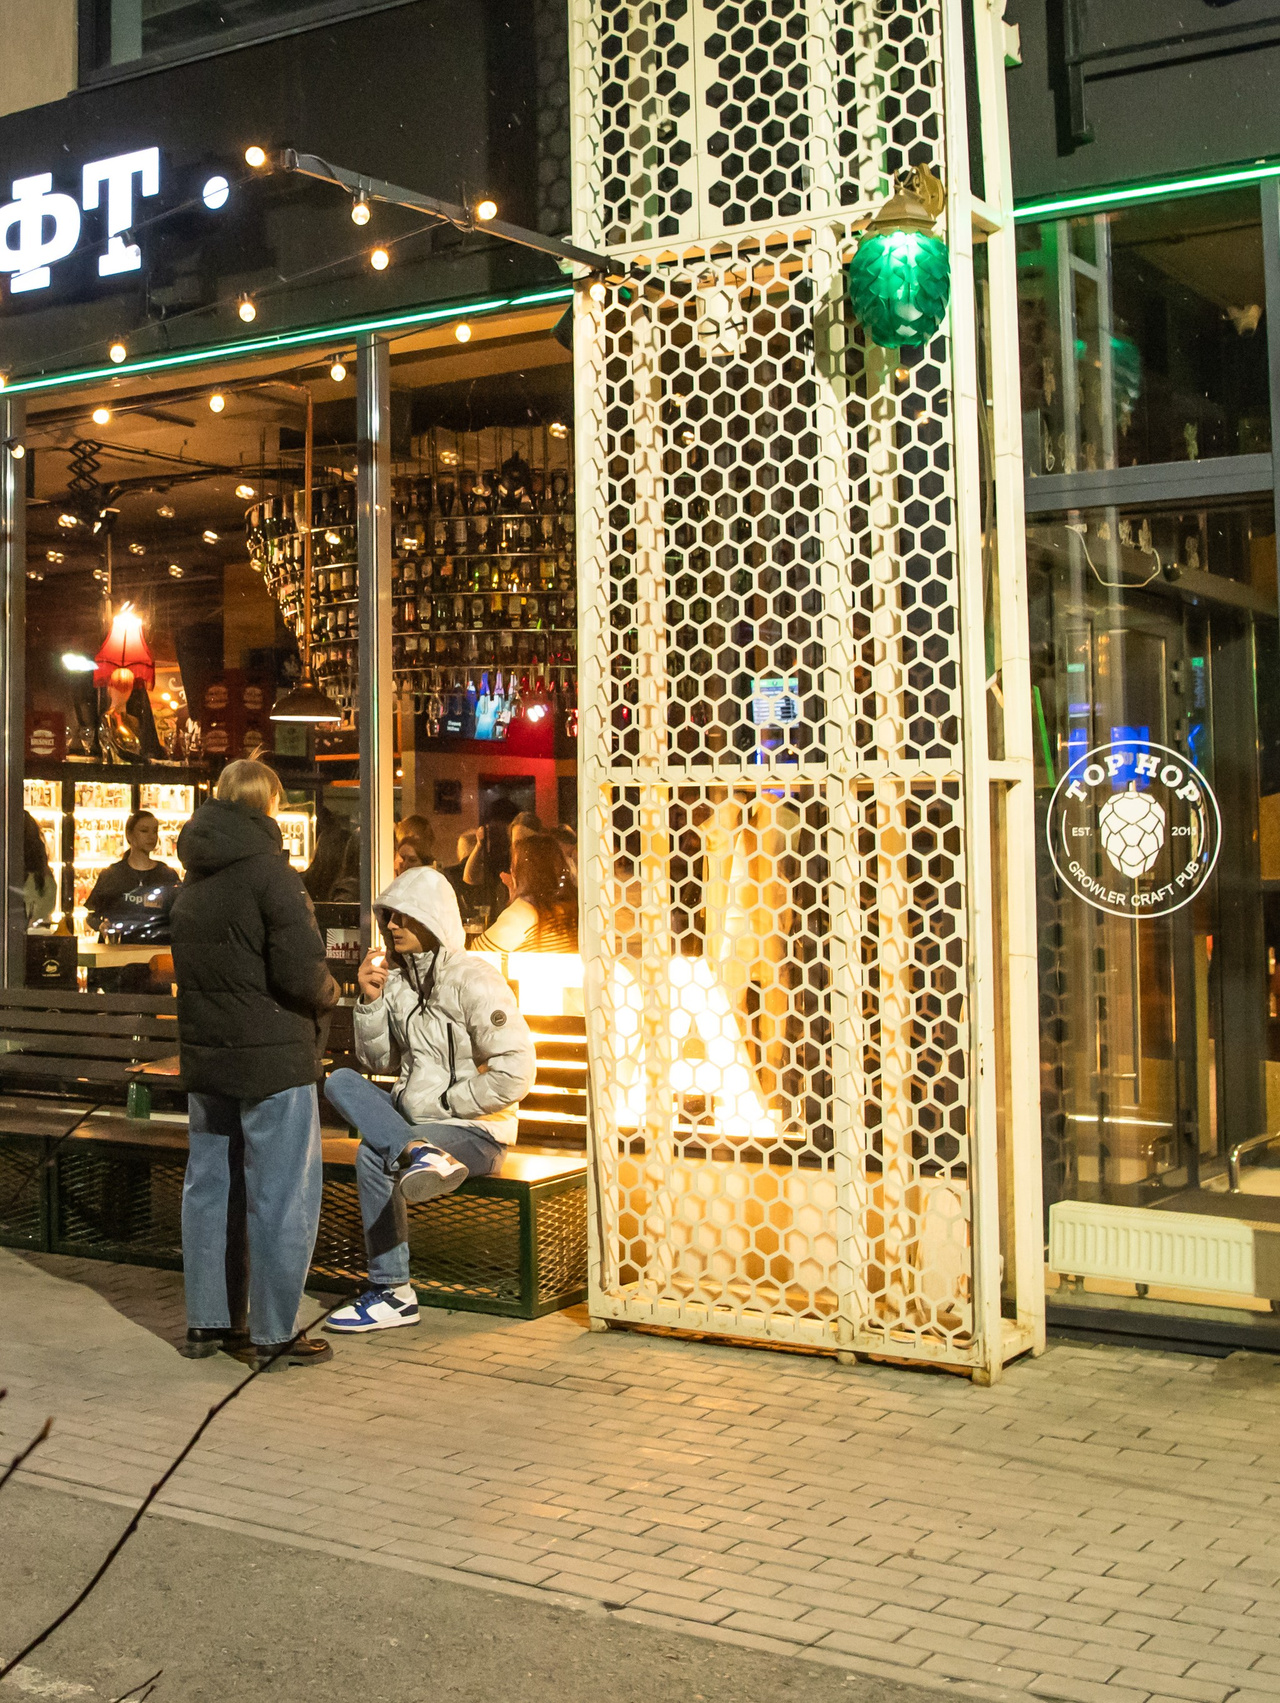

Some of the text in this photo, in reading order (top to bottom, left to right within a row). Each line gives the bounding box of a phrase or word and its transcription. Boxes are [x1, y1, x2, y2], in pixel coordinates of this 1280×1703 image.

[1064, 752, 1200, 802] TOP HOP
[1072, 827, 1093, 837] EST.
[124, 892, 143, 905] Top
[1068, 860, 1200, 907] GROWLER CRAFT PUB
